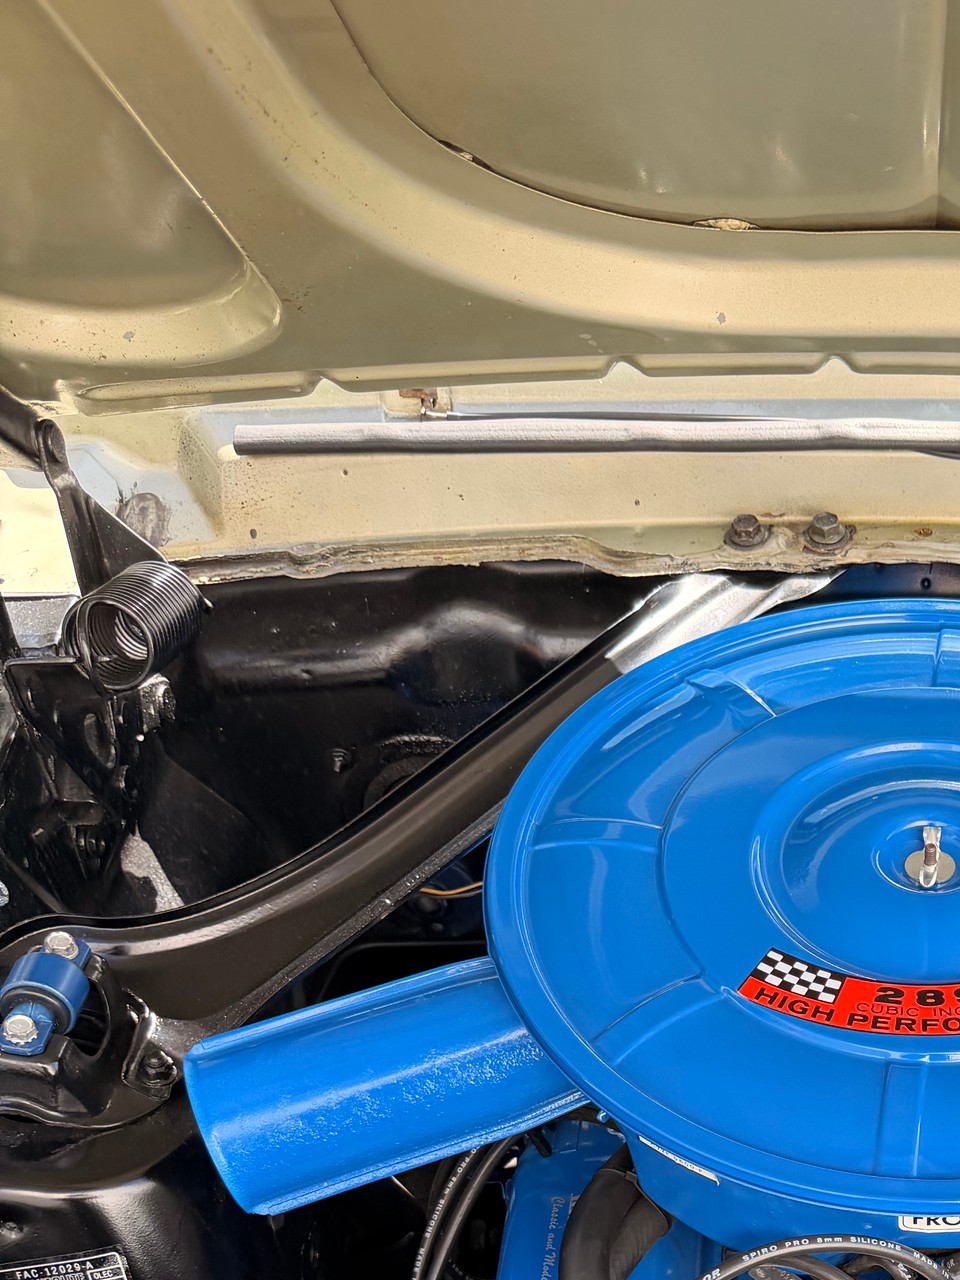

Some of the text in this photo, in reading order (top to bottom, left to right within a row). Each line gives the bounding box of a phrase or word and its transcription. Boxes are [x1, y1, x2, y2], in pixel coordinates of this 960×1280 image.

[754, 987, 835, 1022] HIGH
[856, 1003, 919, 1017] CUBIC
[457, 1156, 470, 1173] PRO
[444, 1176, 457, 1195] 8mm
[424, 1199, 445, 1239] SILICONE
[549, 1196, 565, 1229] Classic
[545, 1232, 556, 1251] and
[413, 1247, 425, 1273] MADE
[742, 1244, 778, 1262] SPIRO
[785, 1238, 810, 1248] PRO
[817, 1236, 843, 1244] 8mm
[850, 1236, 901, 1251] SILICONE
[913, 1251, 939, 1270] MADE
[942, 1269, 950, 1279] IN
[16, 1261, 94, 1280] FAC-12029-A
